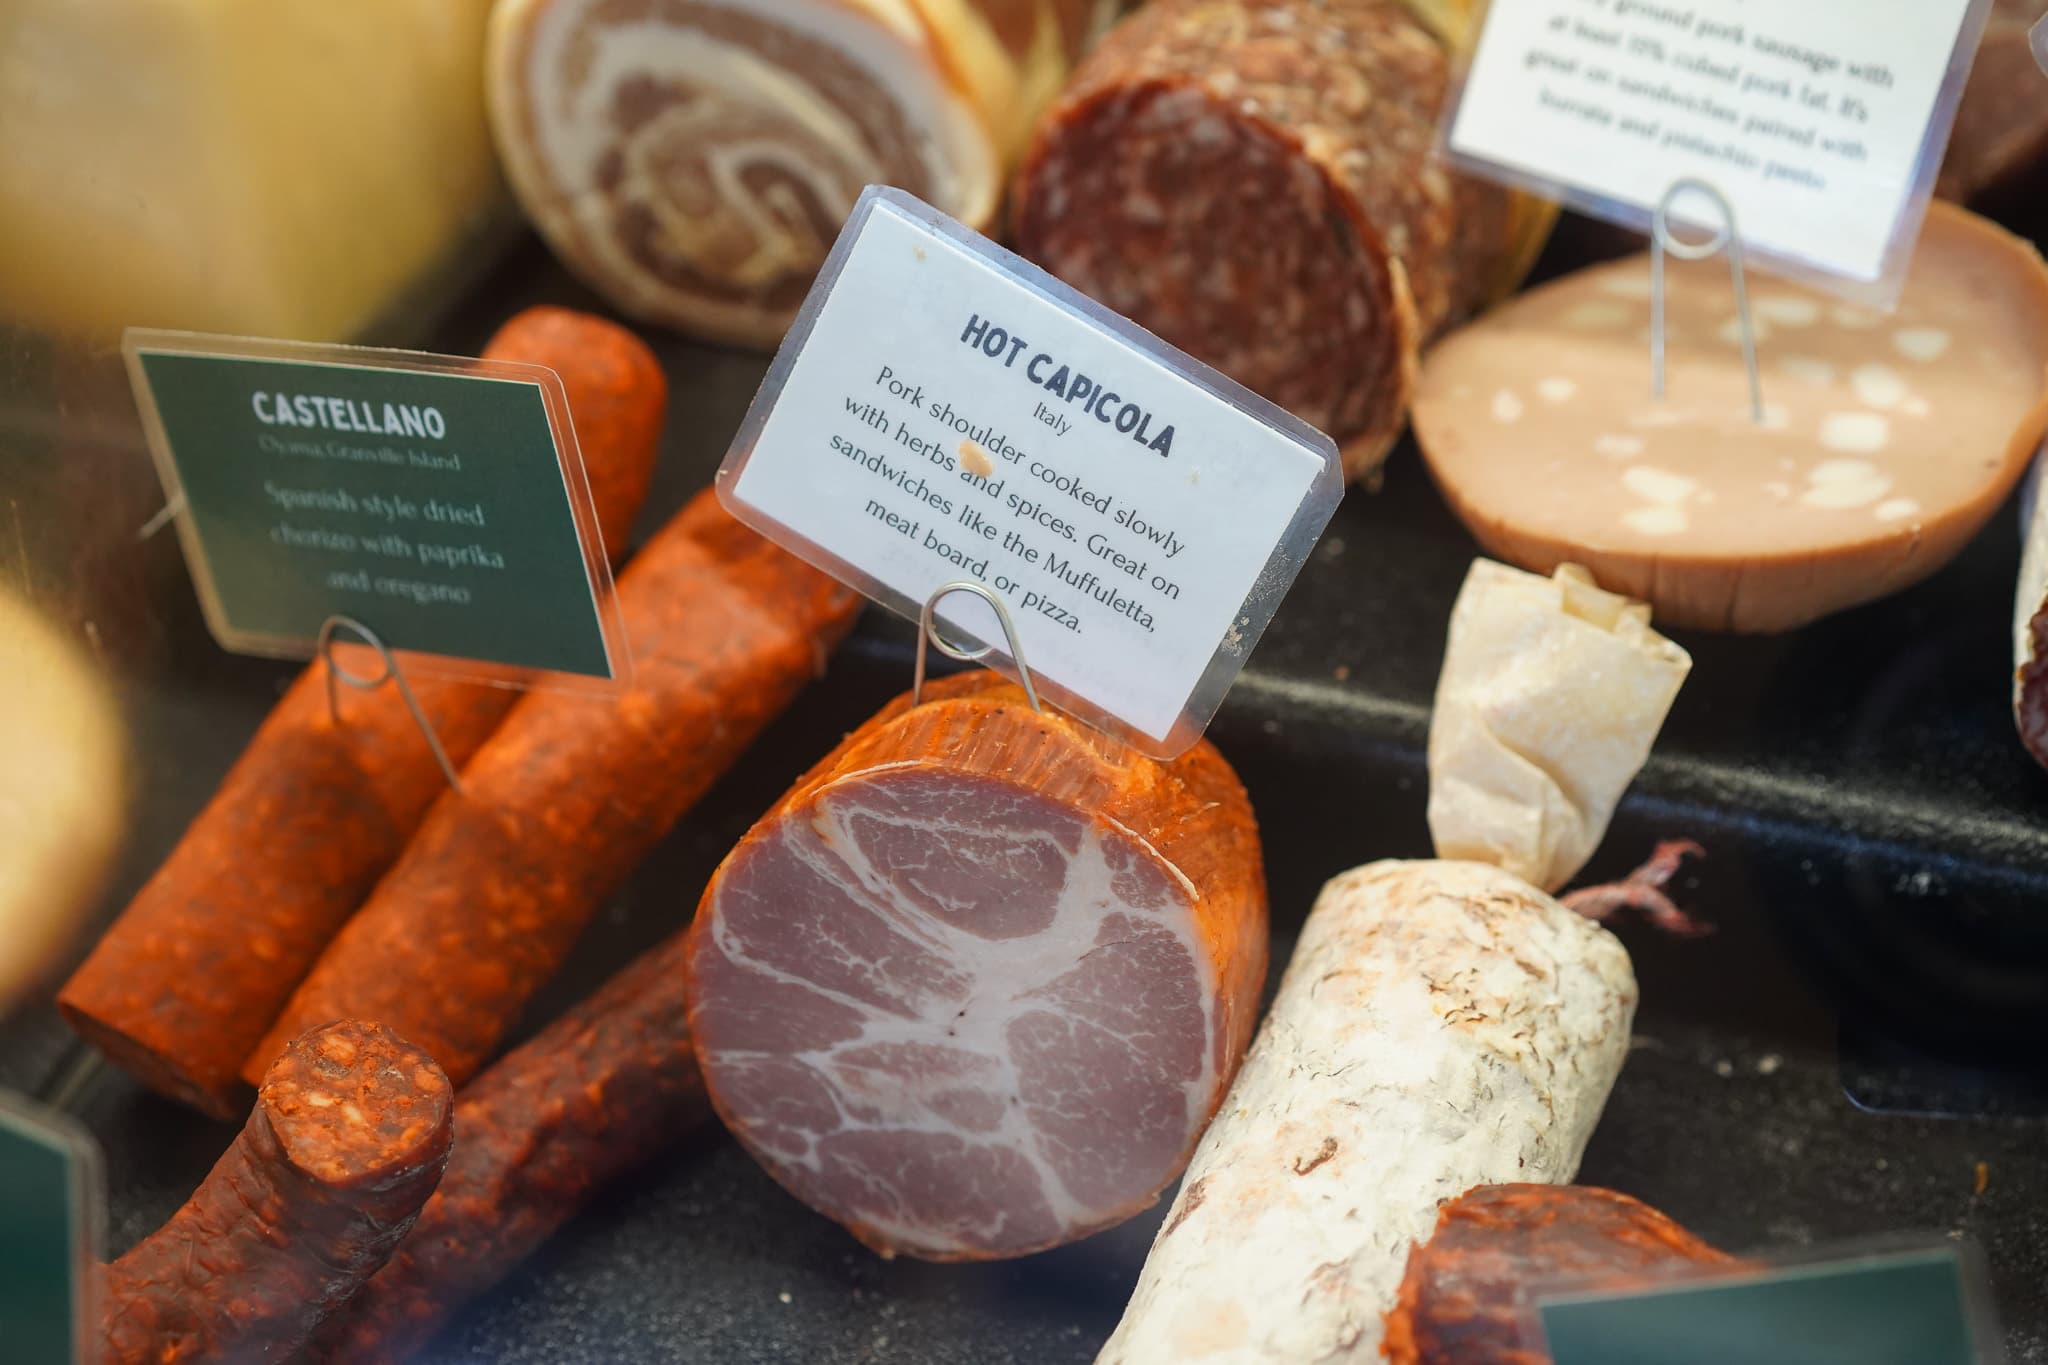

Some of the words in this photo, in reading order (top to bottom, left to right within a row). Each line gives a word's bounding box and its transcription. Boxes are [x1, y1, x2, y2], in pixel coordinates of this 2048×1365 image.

[1695, 18, 1745, 47] pork
[1752, 34, 1841, 76] sausage
[1846, 61, 1895, 90] with
[252, 391, 446, 439] CASTELLANO
[960, 314, 1027, 367] HOT
[1027, 354, 1175, 457] CAPICOLA
[1033, 402, 1072, 436] Italy
[408, 449, 461, 470] Island
[876, 366, 926, 409] Pork
[929, 401, 1026, 465] shoulder
[1030, 462, 1112, 514] cooked
[1114, 507, 1185, 558] slowly
[264, 480, 357, 511] Spanish
[362, 494, 417, 523] style
[424, 499, 485, 526] dried
[845, 397, 889, 434] with
[894, 423, 956, 471] herbs
[960, 469, 1005, 498] and
[1006, 491, 1077, 543] spices.
[1088, 534, 1148, 582] Great
[1151, 572, 1180, 600] on
[360, 534, 412, 558] with
[419, 541, 505, 570] paprika
[830, 434, 953, 515] sandwiches
[960, 505, 997, 540] like
[1003, 531, 1038, 563] the
[1043, 553, 1156, 633] Muffuletta,
[327, 568, 371, 592] and
[374, 577, 470, 604] oregano
[865, 498, 920, 539] meat
[923, 530, 987, 582] board,
[995, 575, 1020, 597] or
[1020, 590, 1082, 634] pizza.
